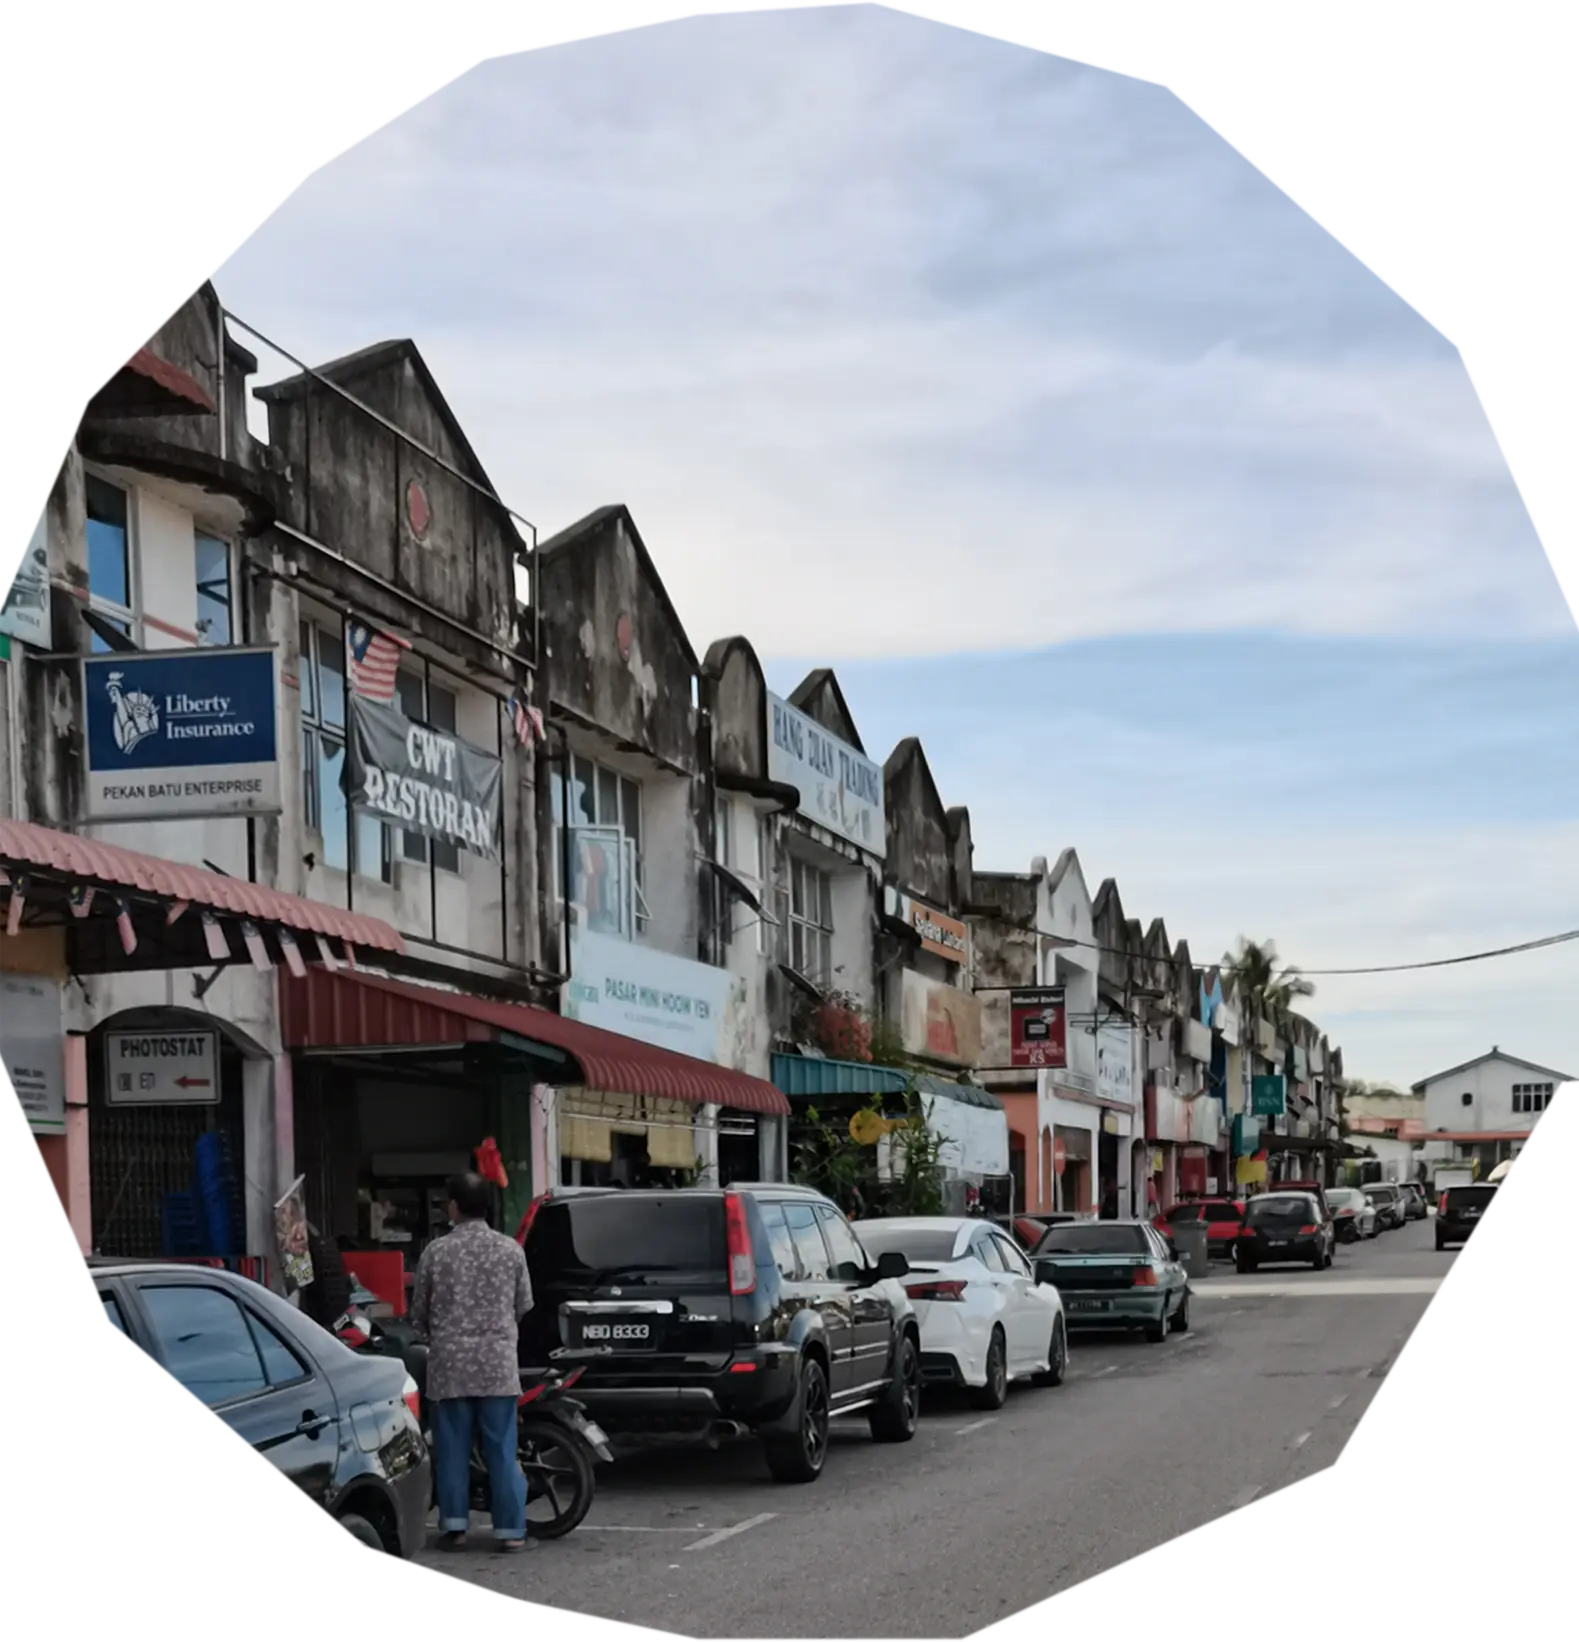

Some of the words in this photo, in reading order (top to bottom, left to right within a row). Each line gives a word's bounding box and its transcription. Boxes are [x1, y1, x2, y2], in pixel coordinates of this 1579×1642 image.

[166, 694, 231, 717] Liberty
[166, 721, 254, 739] Insurance
[406, 725, 456, 781] CWT
[103, 785, 146, 800] PEKAN
[149, 782, 182, 798] BATU
[185, 778, 262, 796] ENTERPRISE
[839, 749, 879, 808] TRADING
[363, 765, 492, 848] RESTORAN
[605, 977, 638, 1004] PASAR
[120, 1037, 206, 1058] PHOTOSTAT
